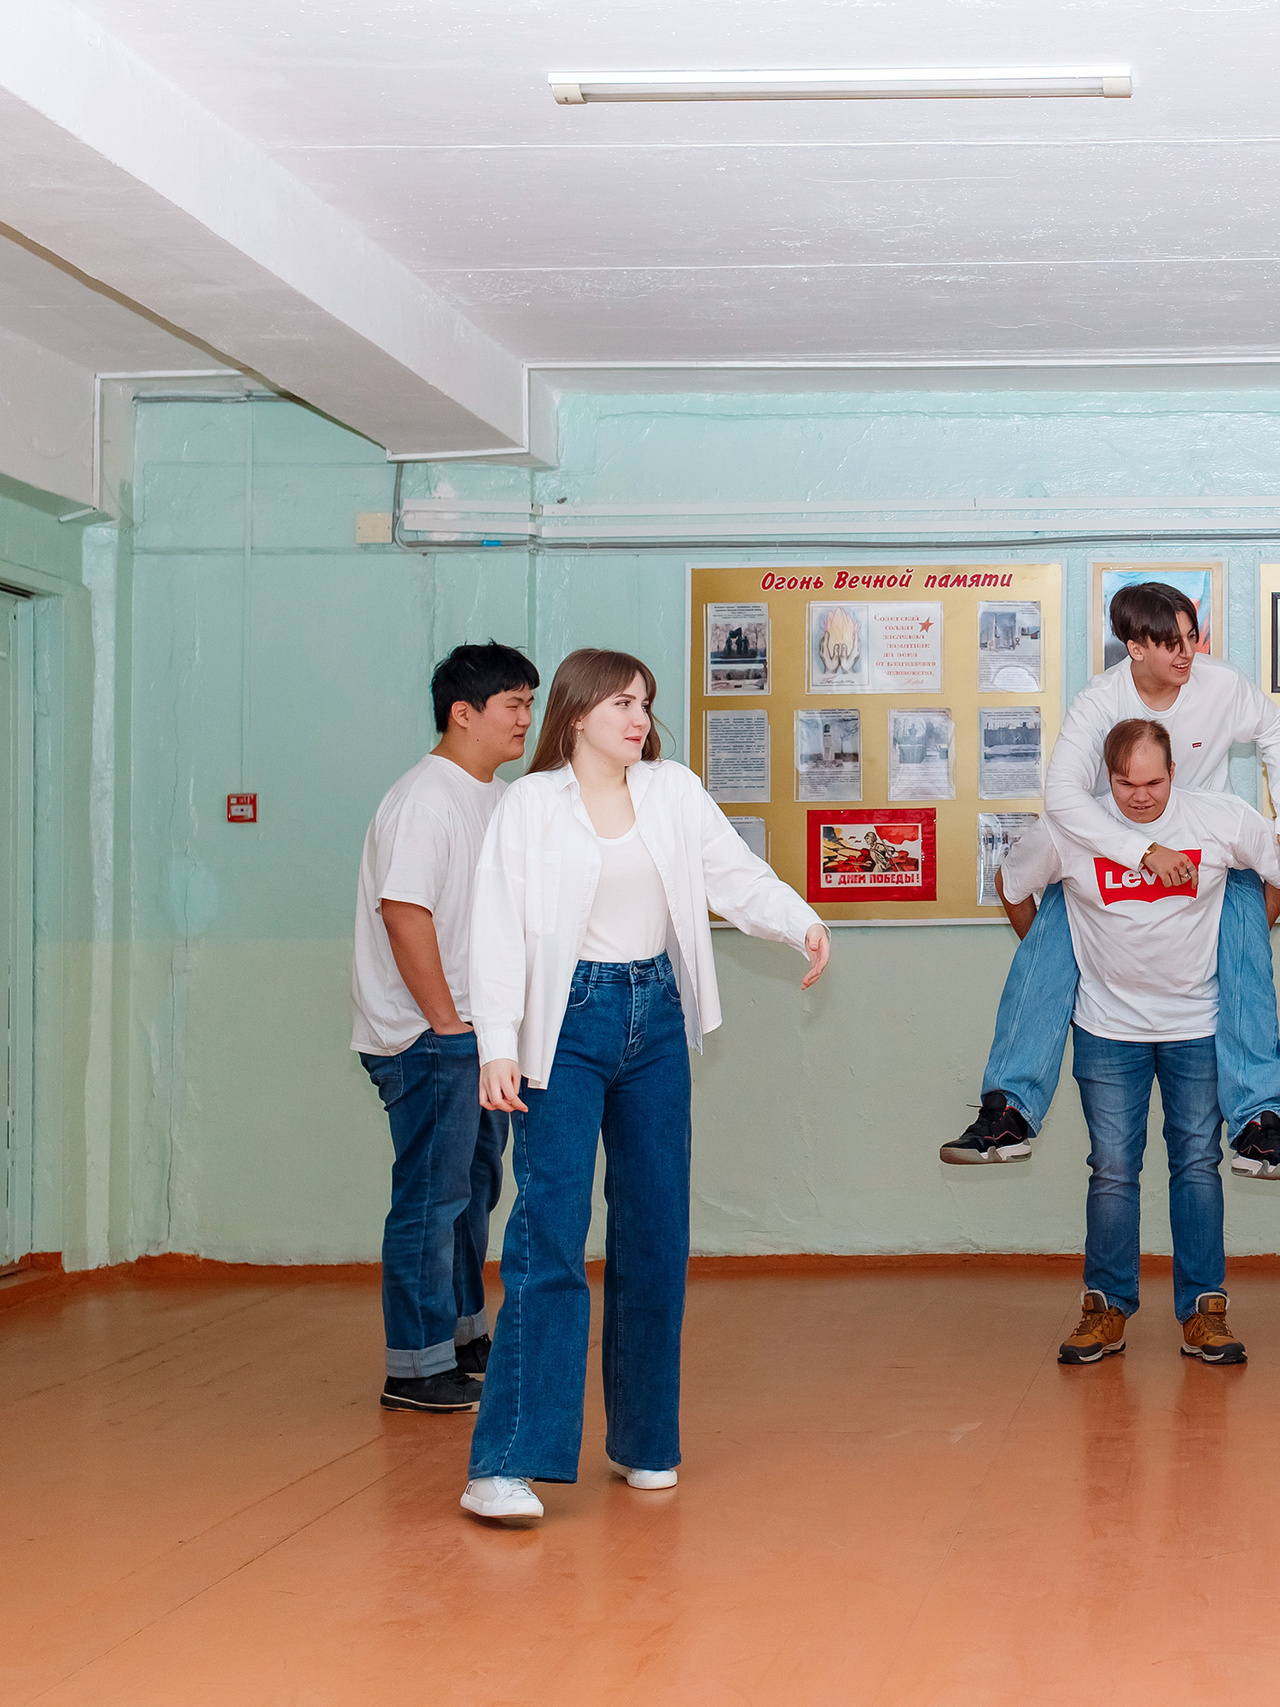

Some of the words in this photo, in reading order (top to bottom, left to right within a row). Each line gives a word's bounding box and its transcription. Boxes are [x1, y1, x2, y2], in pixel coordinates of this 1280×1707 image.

[760, 571, 825, 591] Огонь
[833, 568, 915, 590] Вечной
[923, 572, 1015, 590] памяти
[825, 873, 833, 885] С
[838, 873, 867, 886] ДНЕМ
[869, 872, 920, 885] ПОБЕДЫ!
[1105, 868, 1158, 890] Lev
